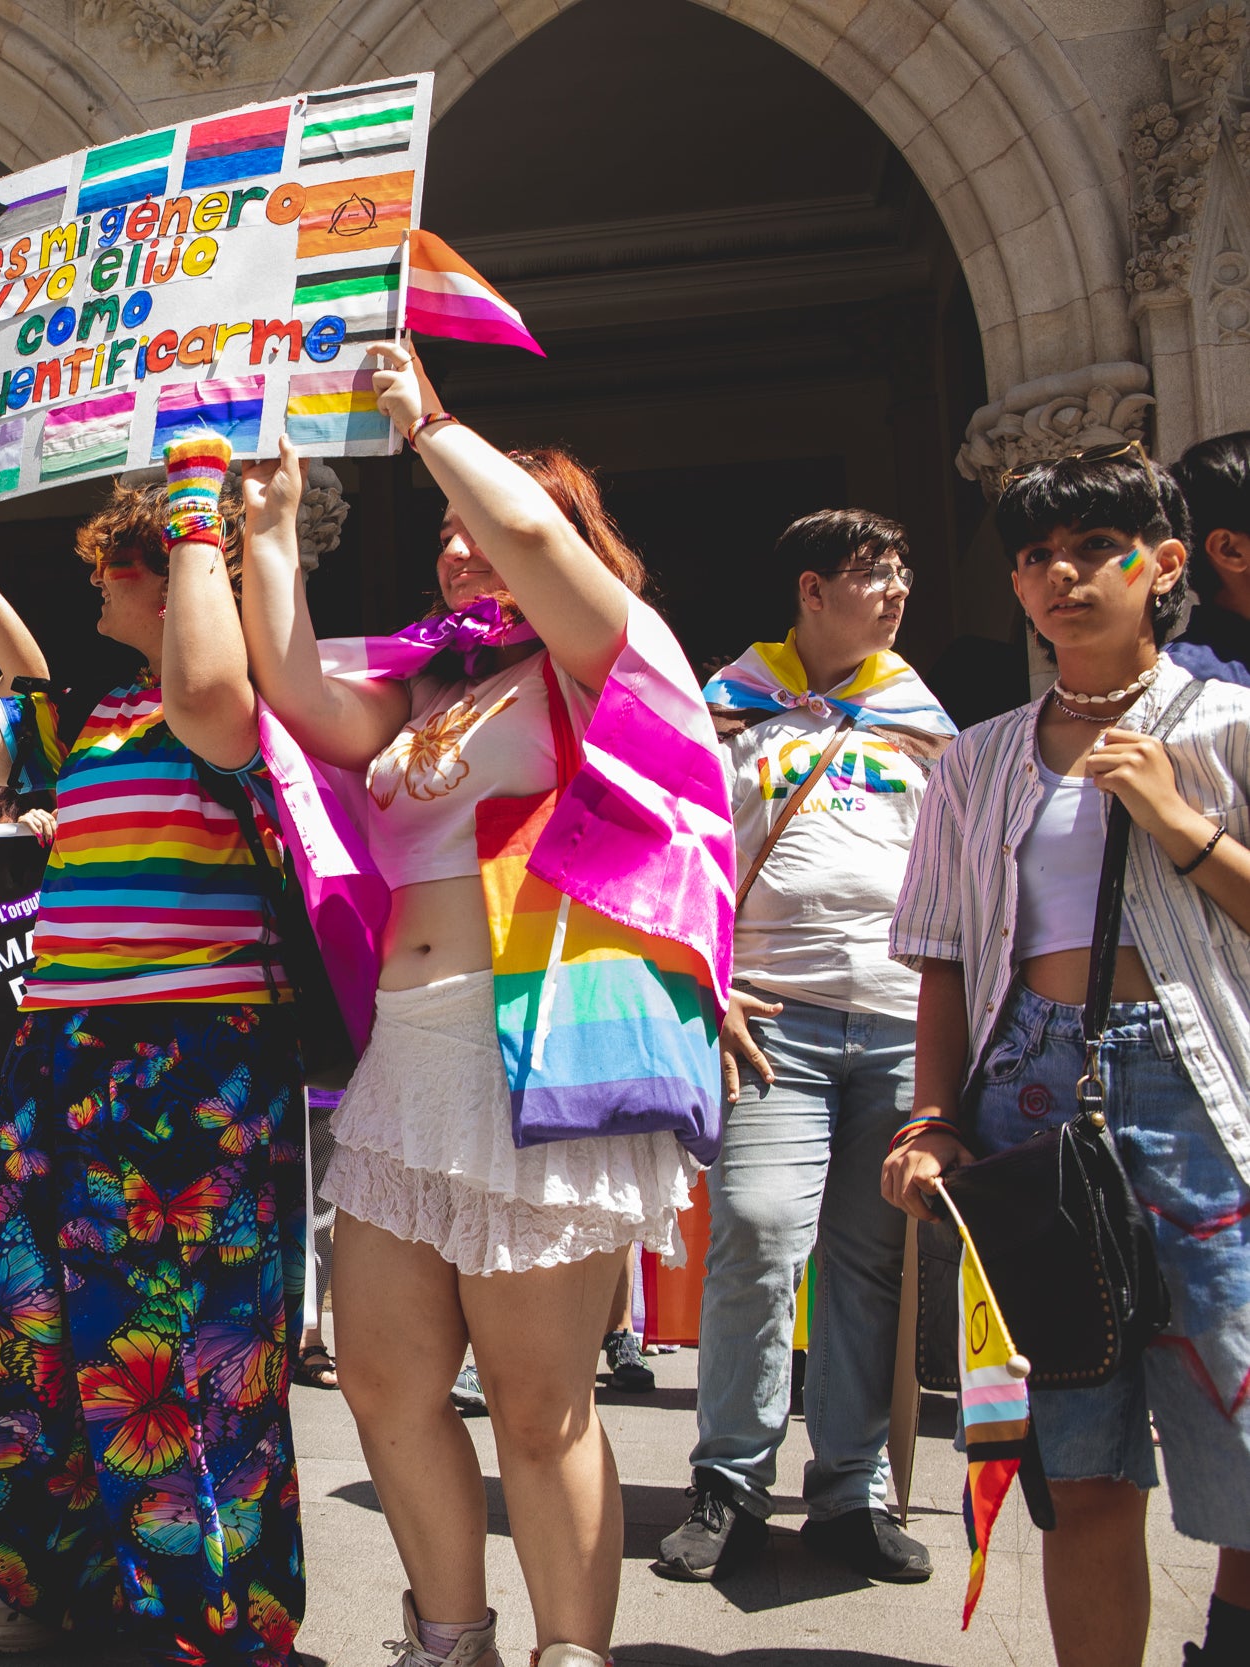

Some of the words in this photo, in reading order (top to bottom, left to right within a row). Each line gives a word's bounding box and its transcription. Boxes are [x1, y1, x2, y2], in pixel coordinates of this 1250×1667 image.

[39, 216, 91, 269] mi
[13, 263, 77, 316] yo
[90, 235, 219, 292] elijo
[16, 290, 153, 356] como
[757, 739, 907, 800] LOVE
[794, 797, 866, 816] LWAYS
